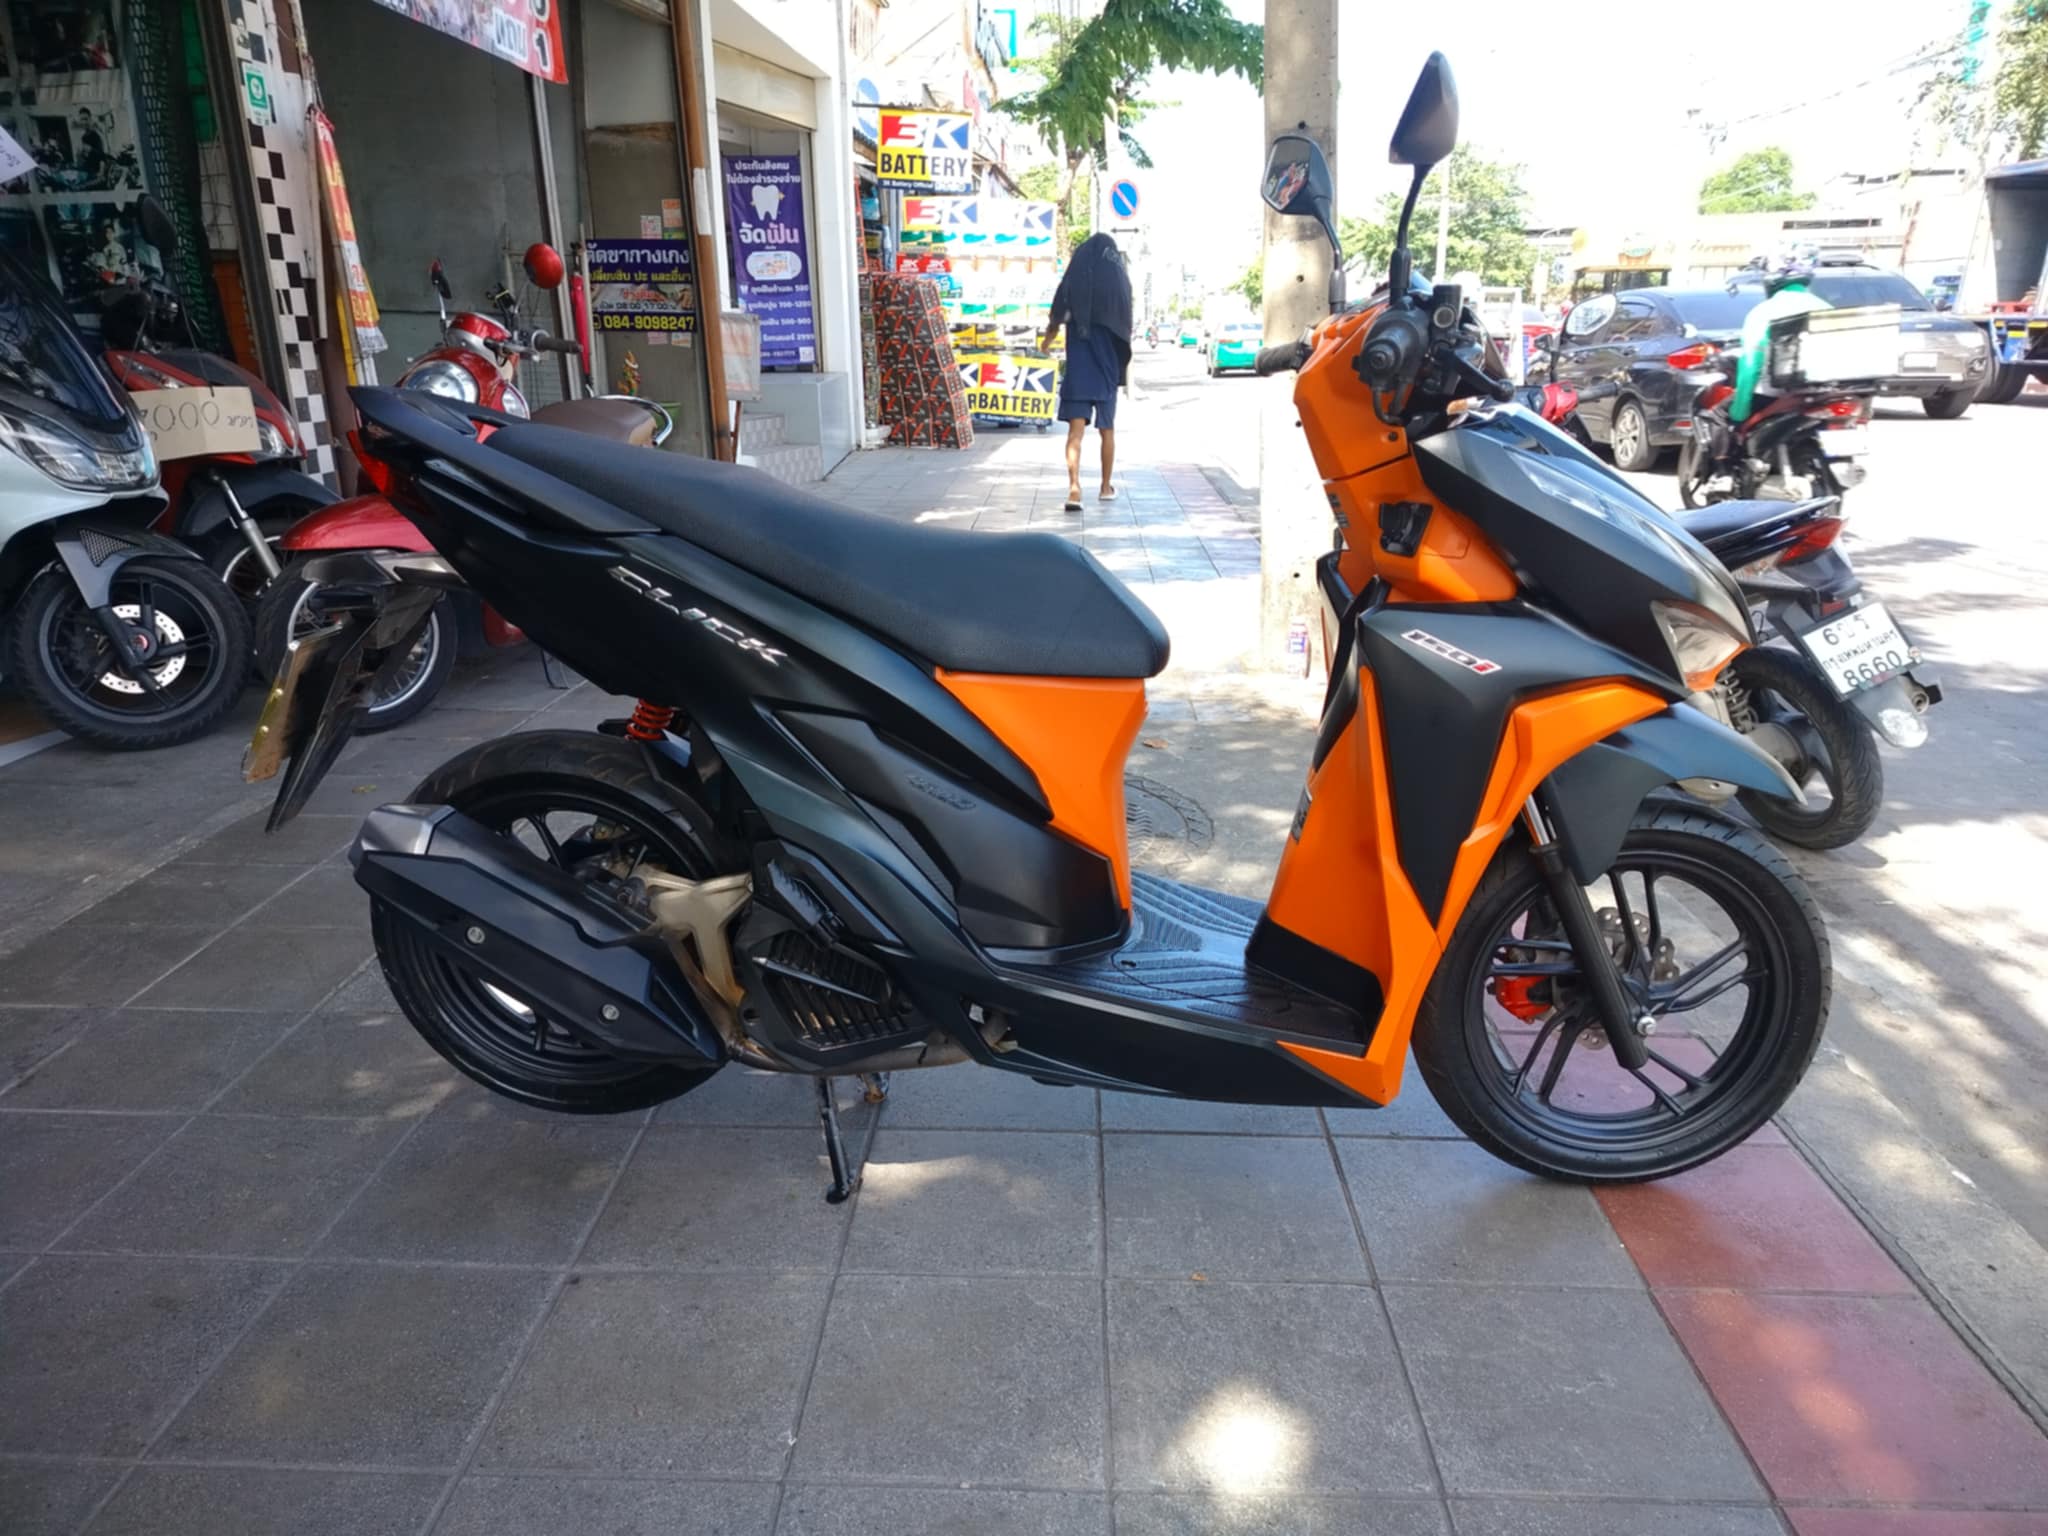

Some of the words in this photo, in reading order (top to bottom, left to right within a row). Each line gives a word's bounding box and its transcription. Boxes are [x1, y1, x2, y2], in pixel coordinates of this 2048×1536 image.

[884, 117, 968, 149] 3K
[881, 153, 967, 177] BATTERY
[908, 200, 976, 225] 3K
[739, 222, 799, 244] จัดฟัน
[603, 315, 694, 330] 084-9098247
[980, 362, 1053, 392] 3K
[979, 393, 1052, 415] BATTERY
[1403, 630, 1500, 673] 150i
[1843, 650, 1901, 688] 8660
